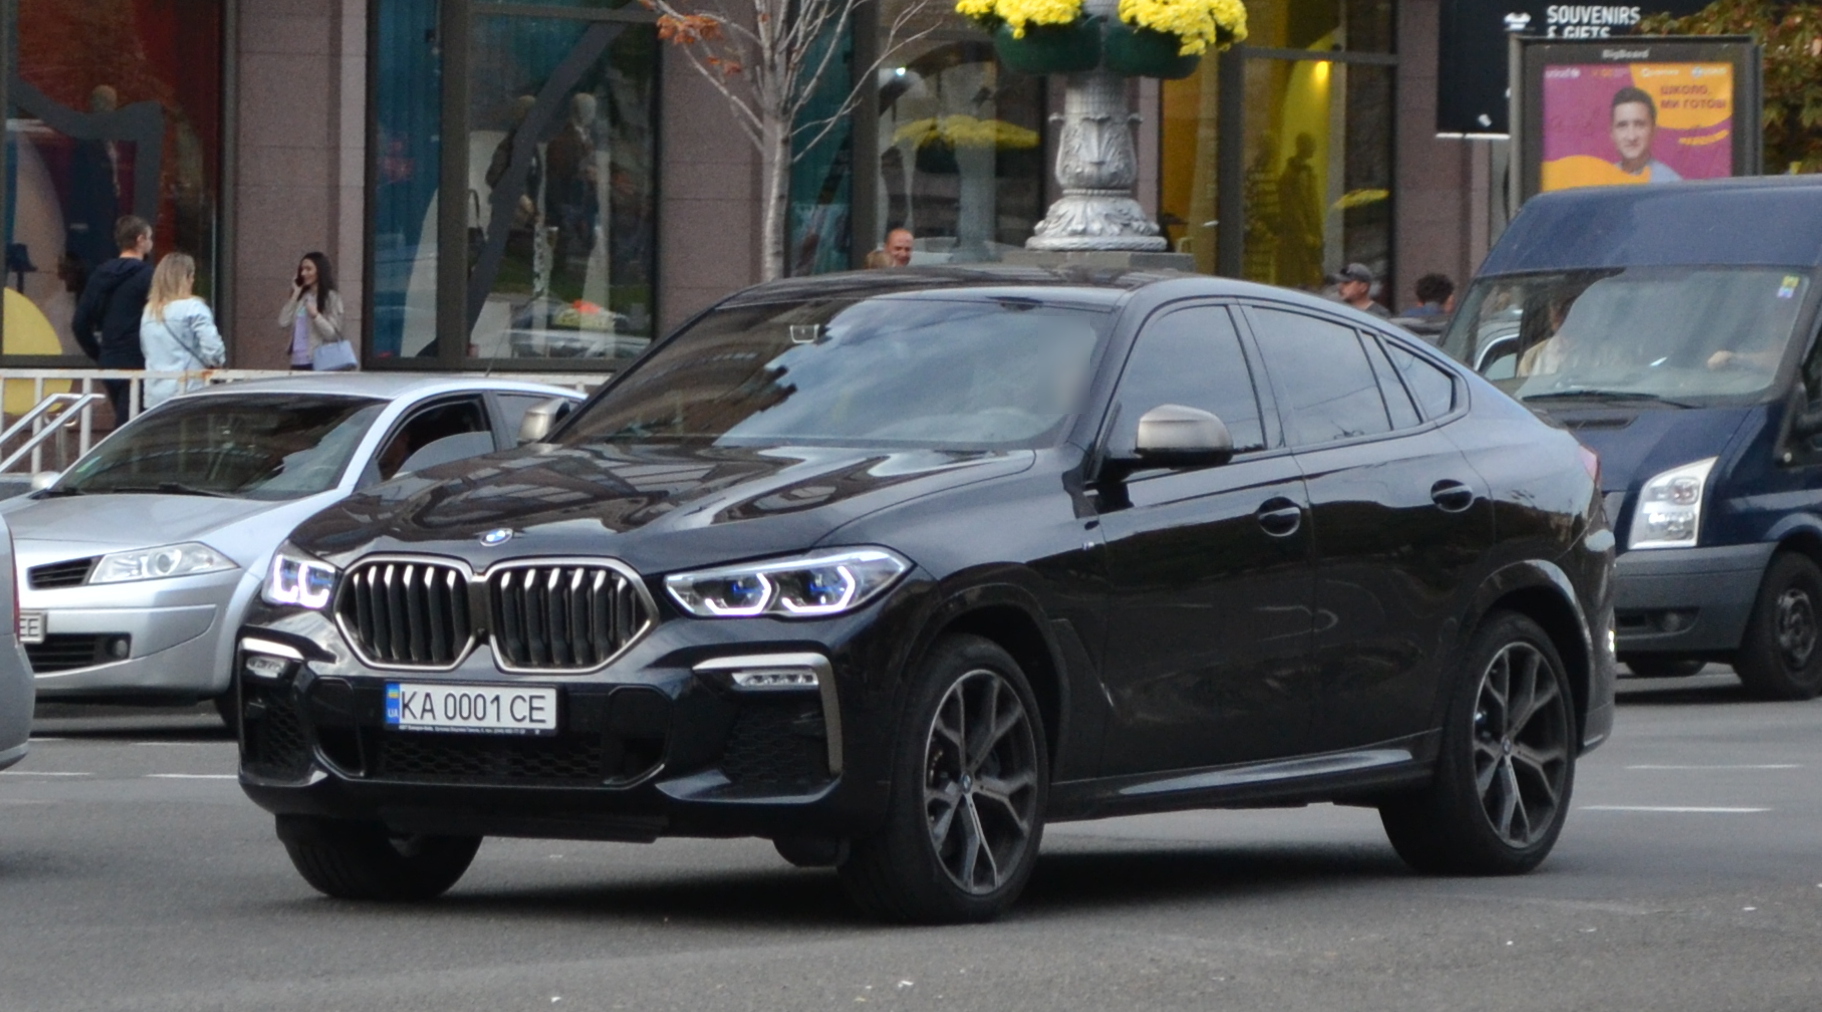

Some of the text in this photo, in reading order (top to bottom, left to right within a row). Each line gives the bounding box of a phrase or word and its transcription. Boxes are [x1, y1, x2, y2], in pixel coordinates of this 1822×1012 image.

[1546, 5, 1641, 25] SOUVENIRS
[1562, 25, 1611, 38] GIFTS
[388, 708, 399, 718] UA
[401, 690, 547, 724] KA 0001 CE
